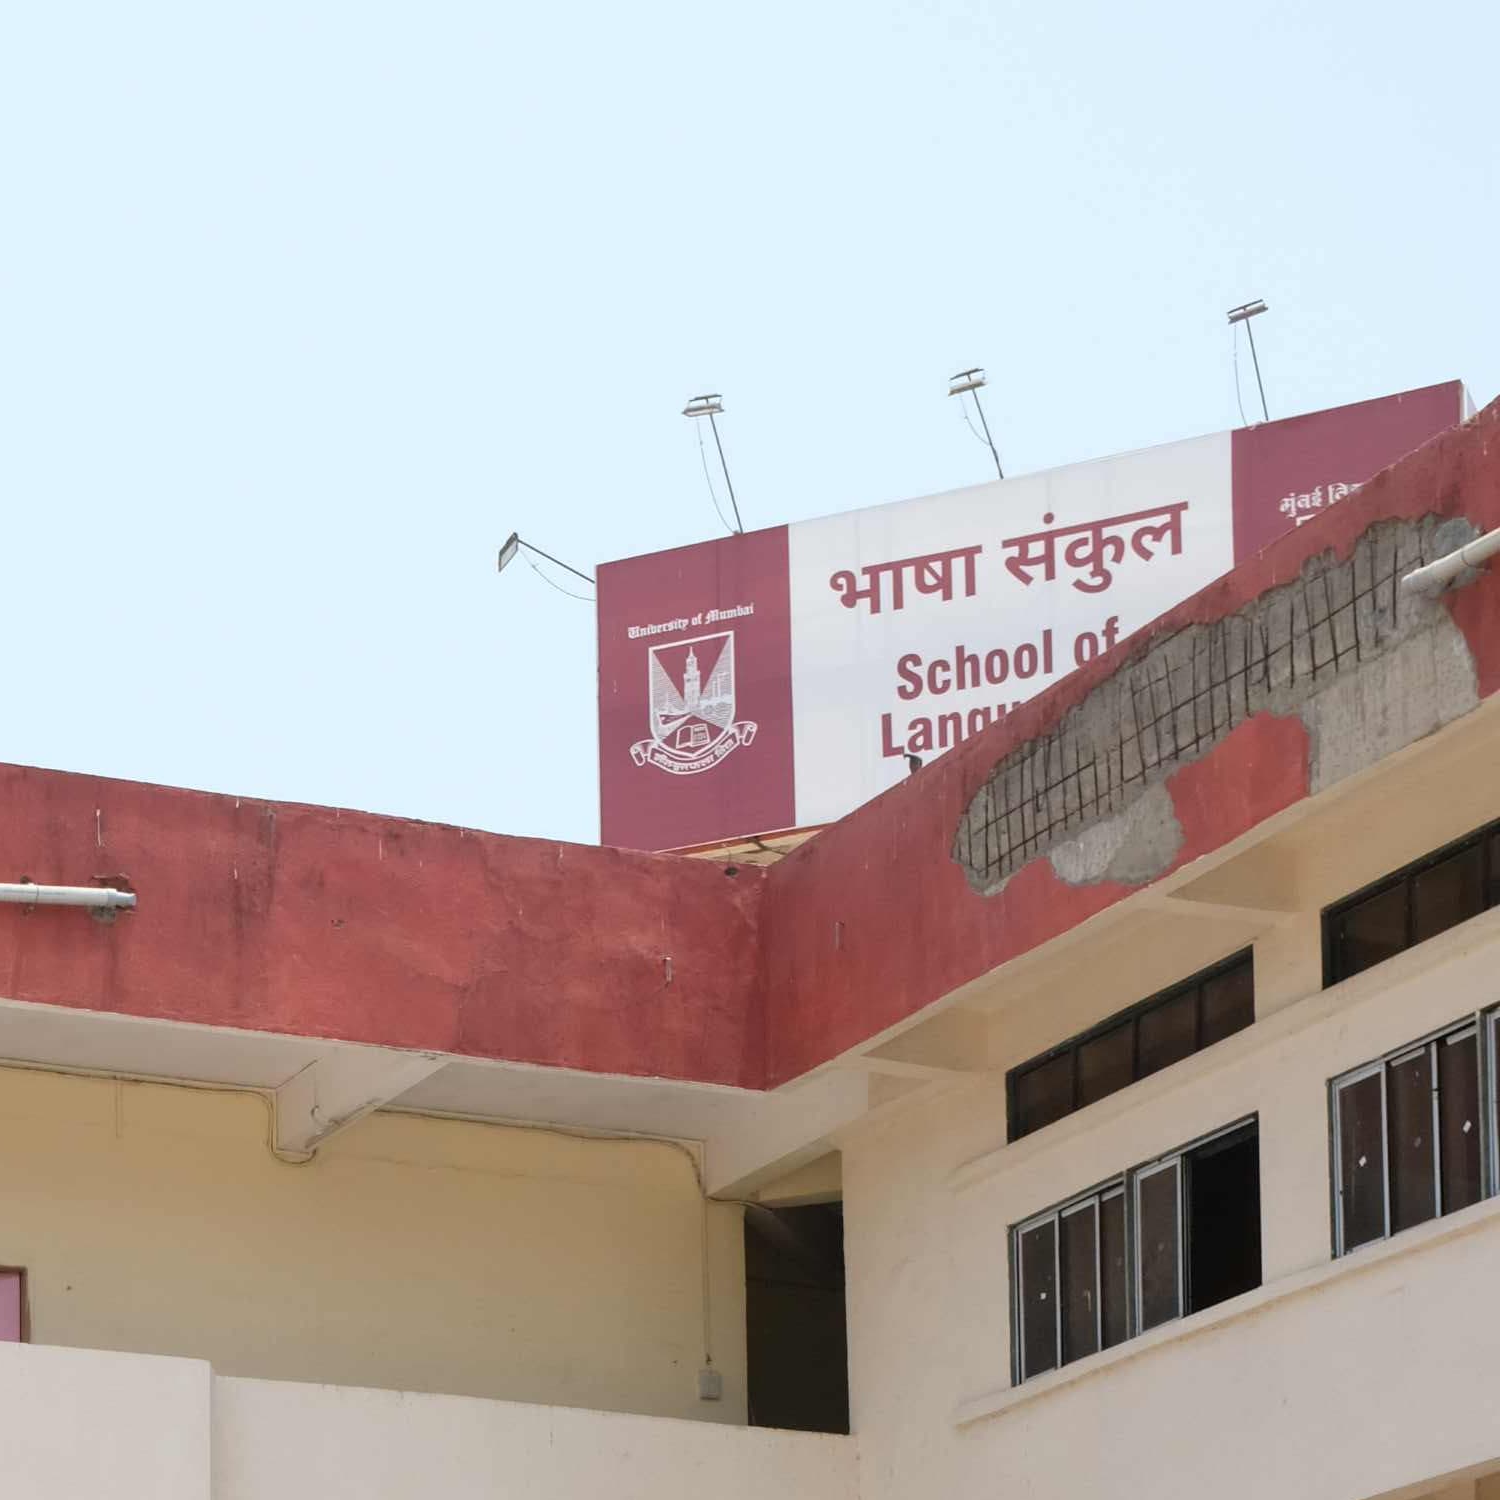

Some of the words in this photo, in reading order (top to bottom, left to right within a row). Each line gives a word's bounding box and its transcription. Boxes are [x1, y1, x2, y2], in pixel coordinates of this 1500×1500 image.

[830, 544, 983, 615] भाषा
[1002, 501, 1189, 593] संकुल
[627, 618, 689, 639] University
[692, 613, 703, 626] of
[704, 603, 754, 625] Mumbai
[896, 629, 1053, 701] School
[1073, 616, 1120, 668] of
